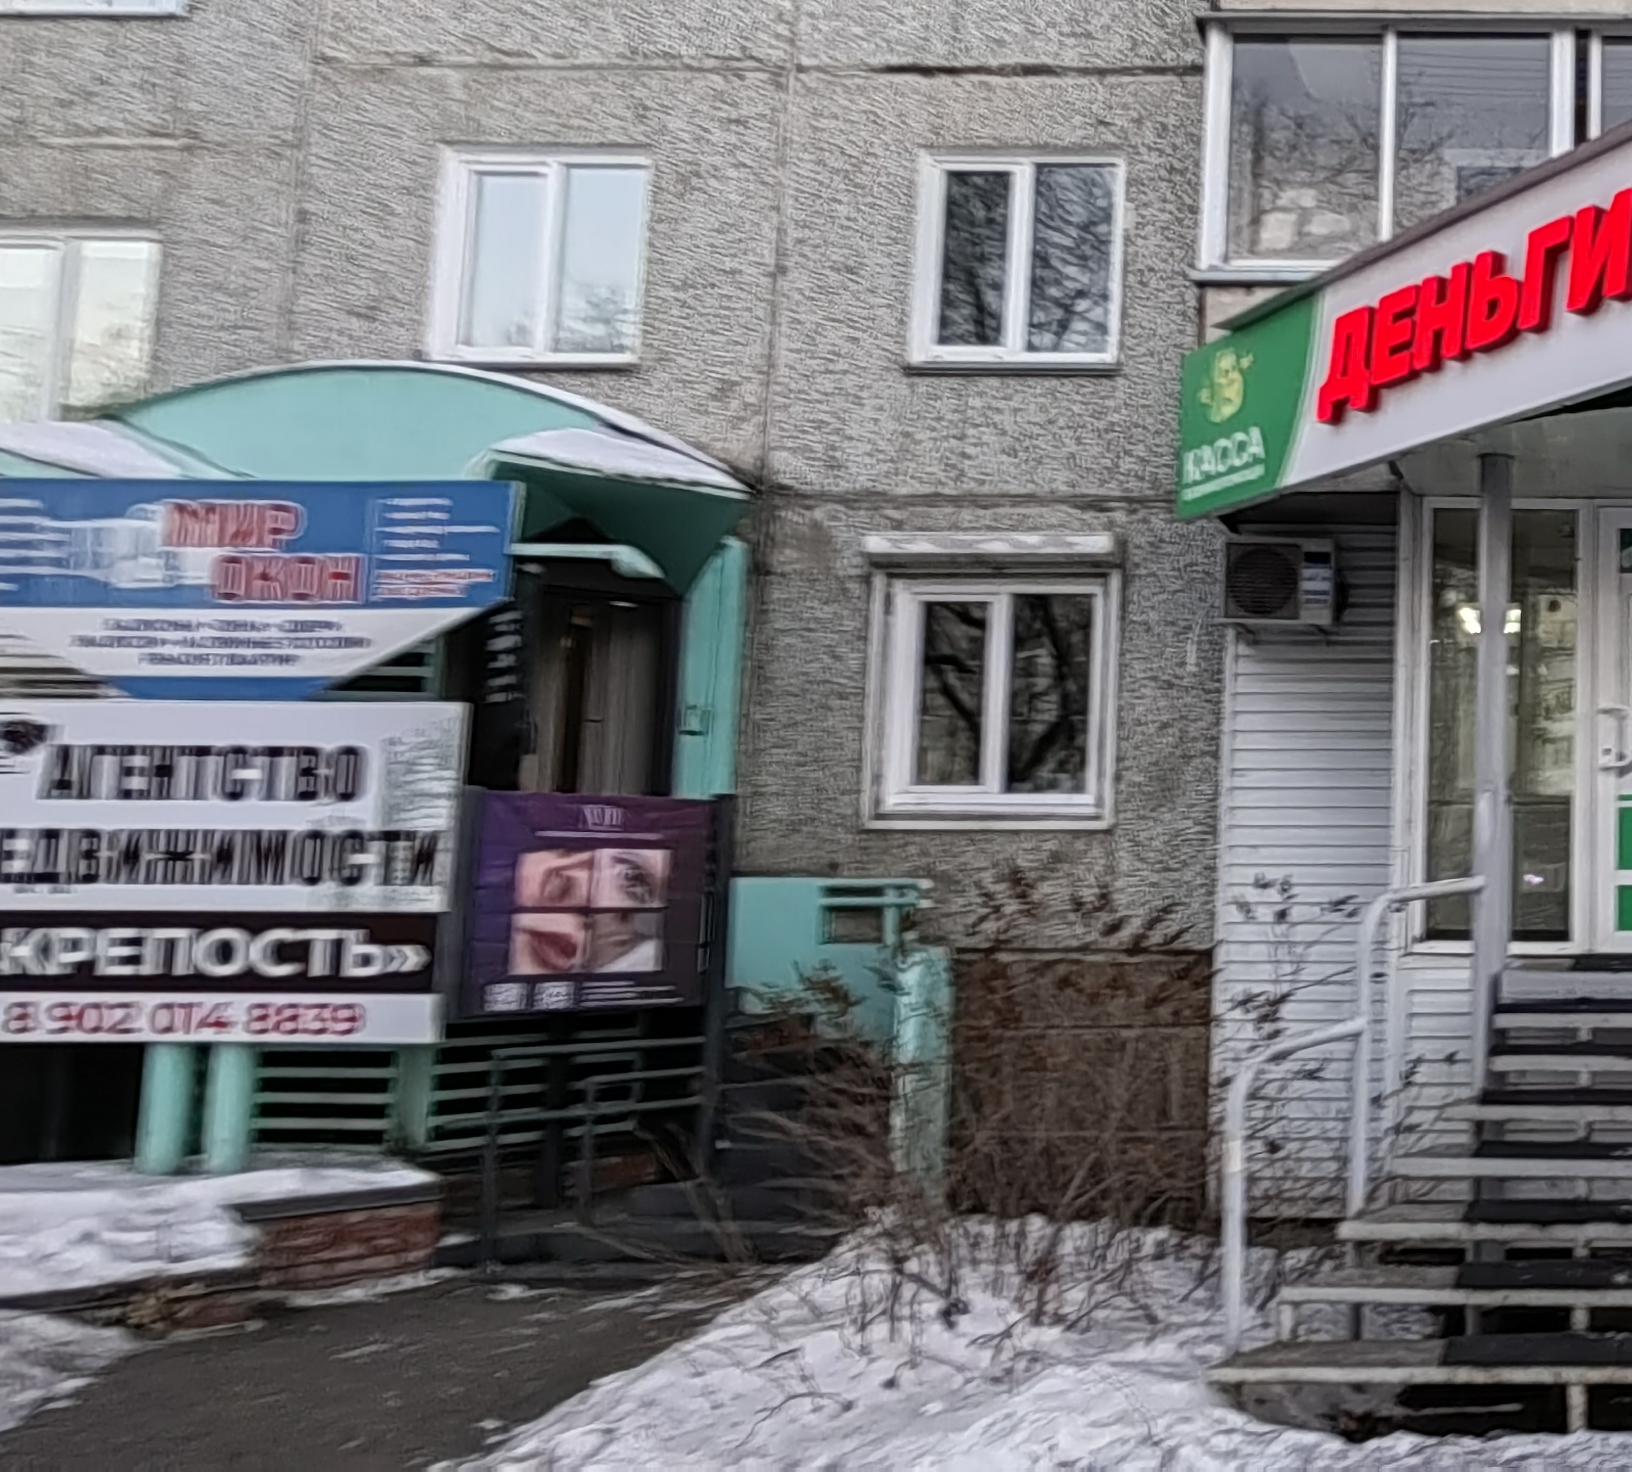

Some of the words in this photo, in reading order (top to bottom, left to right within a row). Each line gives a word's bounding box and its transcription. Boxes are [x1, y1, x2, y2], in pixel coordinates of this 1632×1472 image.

[1182, 426, 1266, 484] КАССА
[162, 499, 303, 549] МИР
[211, 552, 365, 602] ОКОН
[38, 744, 366, 801] АГЕНТСТВО
[0, 926, 431, 977] КРЕПОСТЬ»
[1, 1001, 40, 1035] 8
[44, 1001, 143, 1035] 902
[243, 1001, 367, 1036] 8839
